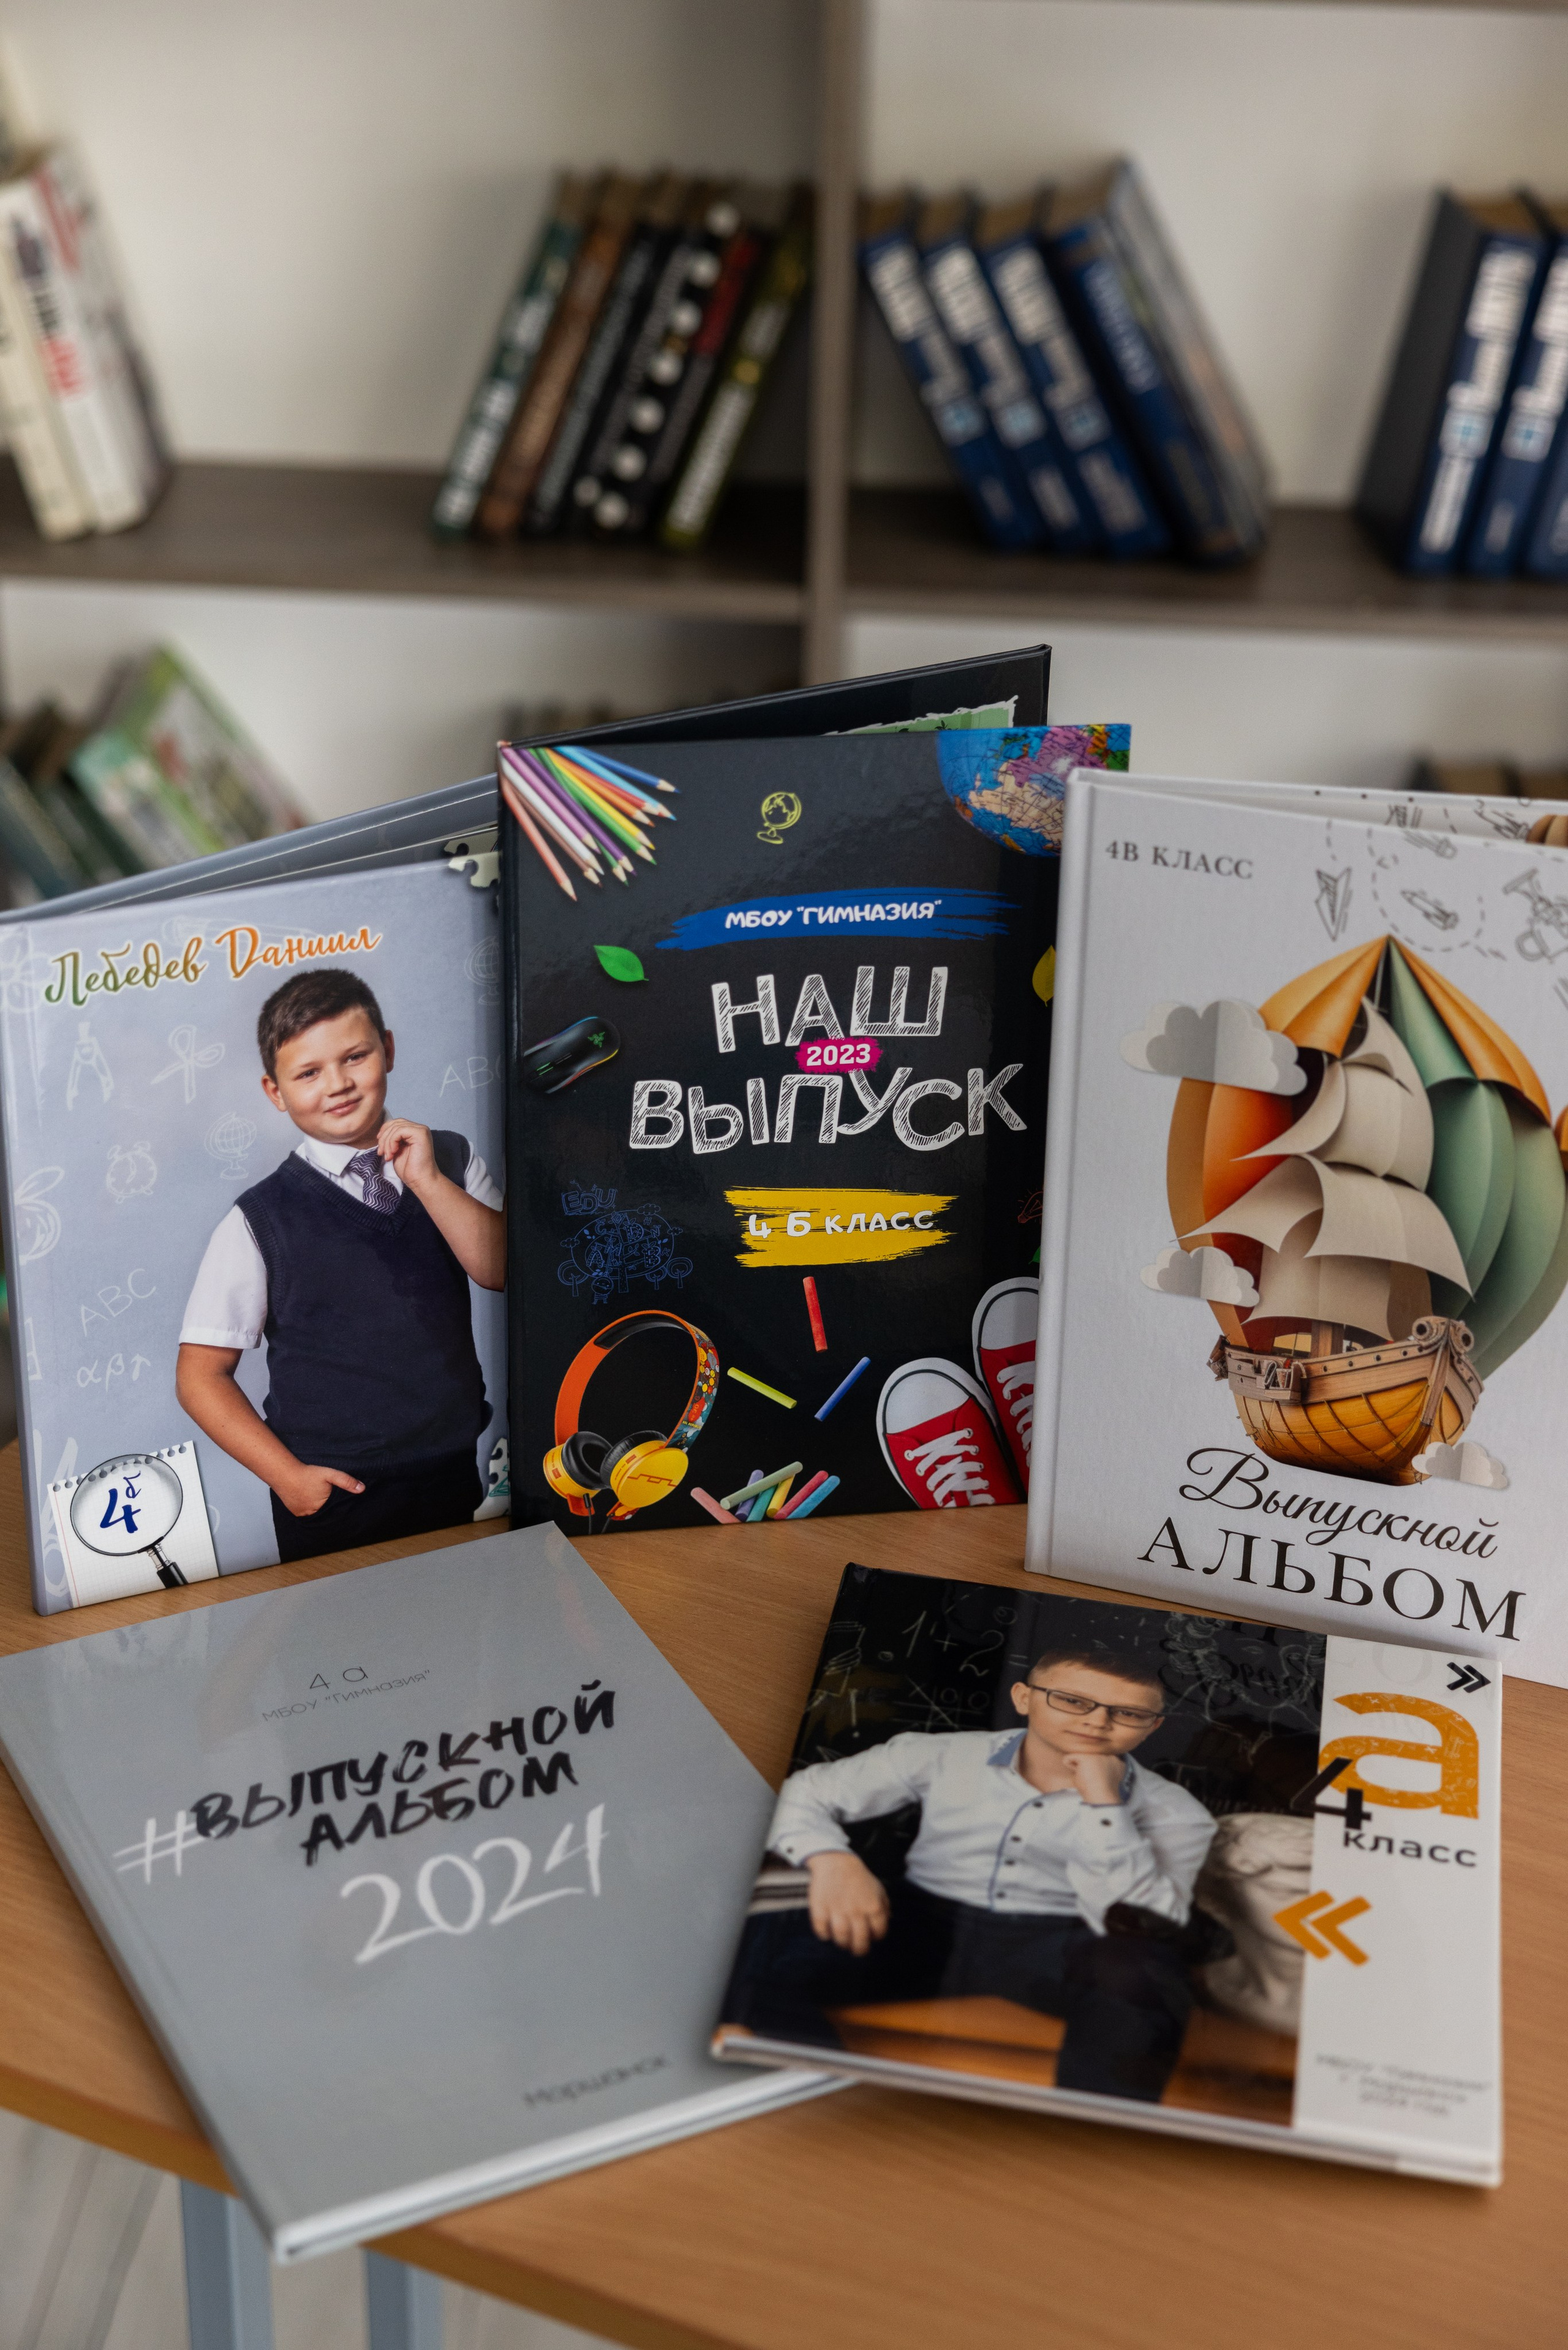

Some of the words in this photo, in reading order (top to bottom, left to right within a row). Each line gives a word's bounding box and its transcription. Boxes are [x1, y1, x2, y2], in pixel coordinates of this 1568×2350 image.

[1105, 840, 1139, 862] 4В
[1152, 846, 1253, 880] КЛАСС
[725, 908, 793, 930] МБОУ
[796, 898, 943, 925] "ГИМНАЗИЯ"
[44, 933, 208, 1008] Лебедев
[711, 966, 949, 1054] НАШ
[805, 1042, 872, 1067] 2023
[628, 1063, 1028, 1154] ВЫПУСК
[562, 1188, 617, 1215] EDU
[748, 1214, 772, 1239] 4
[786, 1211, 811, 1237] Б
[80, 1268, 157, 1338] ABC
[1178, 1447, 1498, 1559] Выпускной
[1137, 1516, 1527, 1643] АЛЬБОМ
[262, 1699, 317, 1722] МБОУ
[325, 1670, 431, 1704] "Гимназия"
[309, 1673, 331, 1690] 4
[300, 1749, 579, 1867] АЛЬБОМ
[1290, 1756, 1373, 1831] 4
[339, 1802, 609, 1965] 2024
[1343, 1829, 1477, 1869] класс
